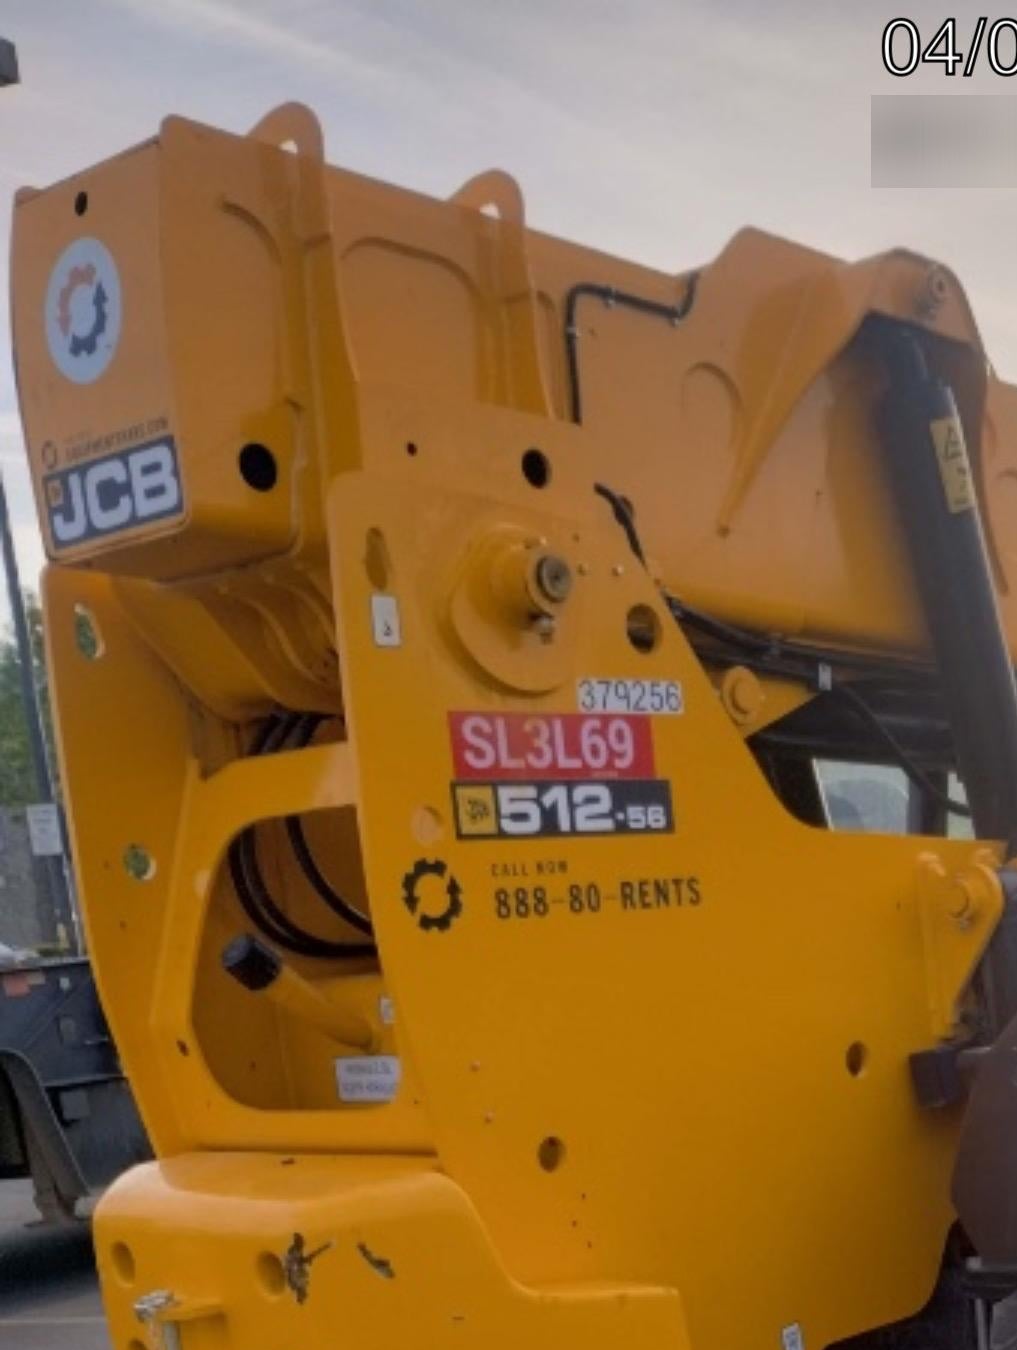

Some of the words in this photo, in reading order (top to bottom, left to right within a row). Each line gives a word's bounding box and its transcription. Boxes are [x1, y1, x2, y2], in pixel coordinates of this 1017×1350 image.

[53, 444, 178, 541] JCB
[580, 681, 681, 712] 379256
[461, 716, 636, 770] SL3L69
[491, 863, 529, 877] CALL
[536, 860, 568, 875] NOW
